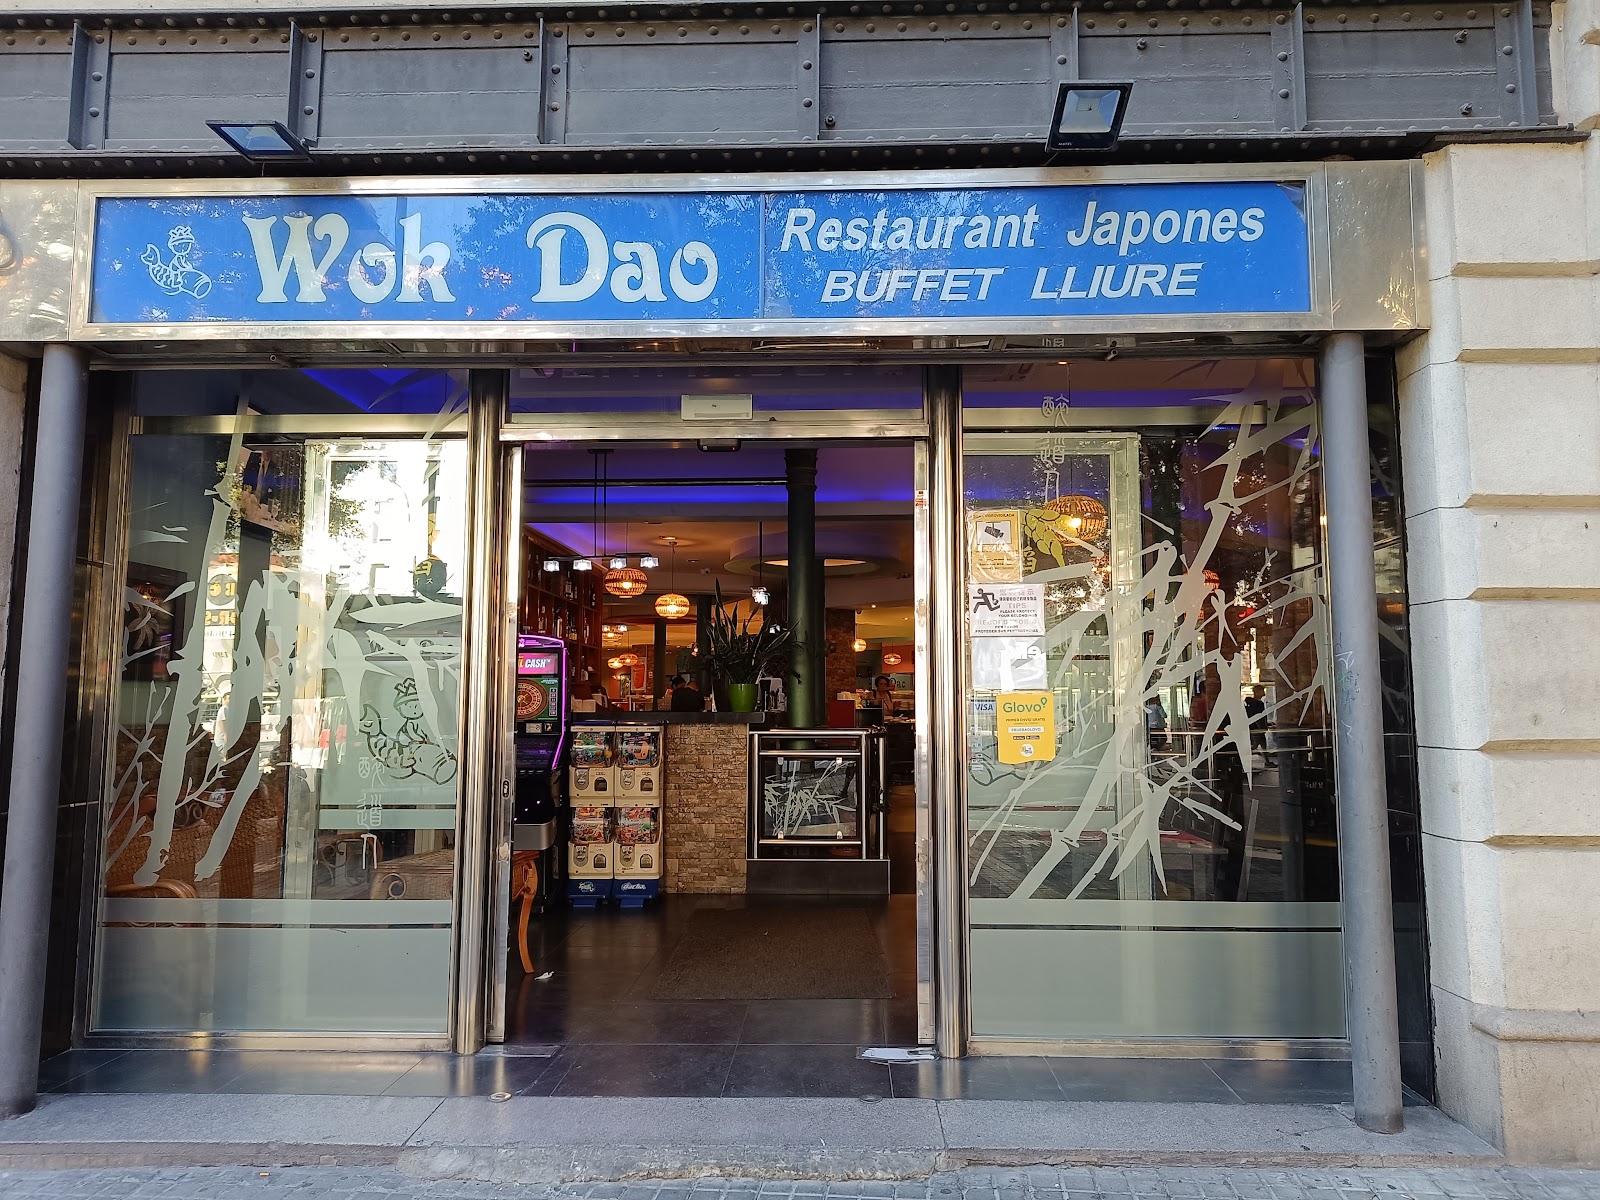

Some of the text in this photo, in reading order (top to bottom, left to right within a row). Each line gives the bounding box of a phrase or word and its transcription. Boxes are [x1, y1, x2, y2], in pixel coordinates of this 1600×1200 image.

[780, 202, 1265, 257] Restaurant Japones
[242, 210, 719, 304] Wok Dao
[821, 262, 1203, 303] BUFFET LLIURE
[975, 703, 994, 711] VISA
[1003, 702, 1042, 713] Glovo
